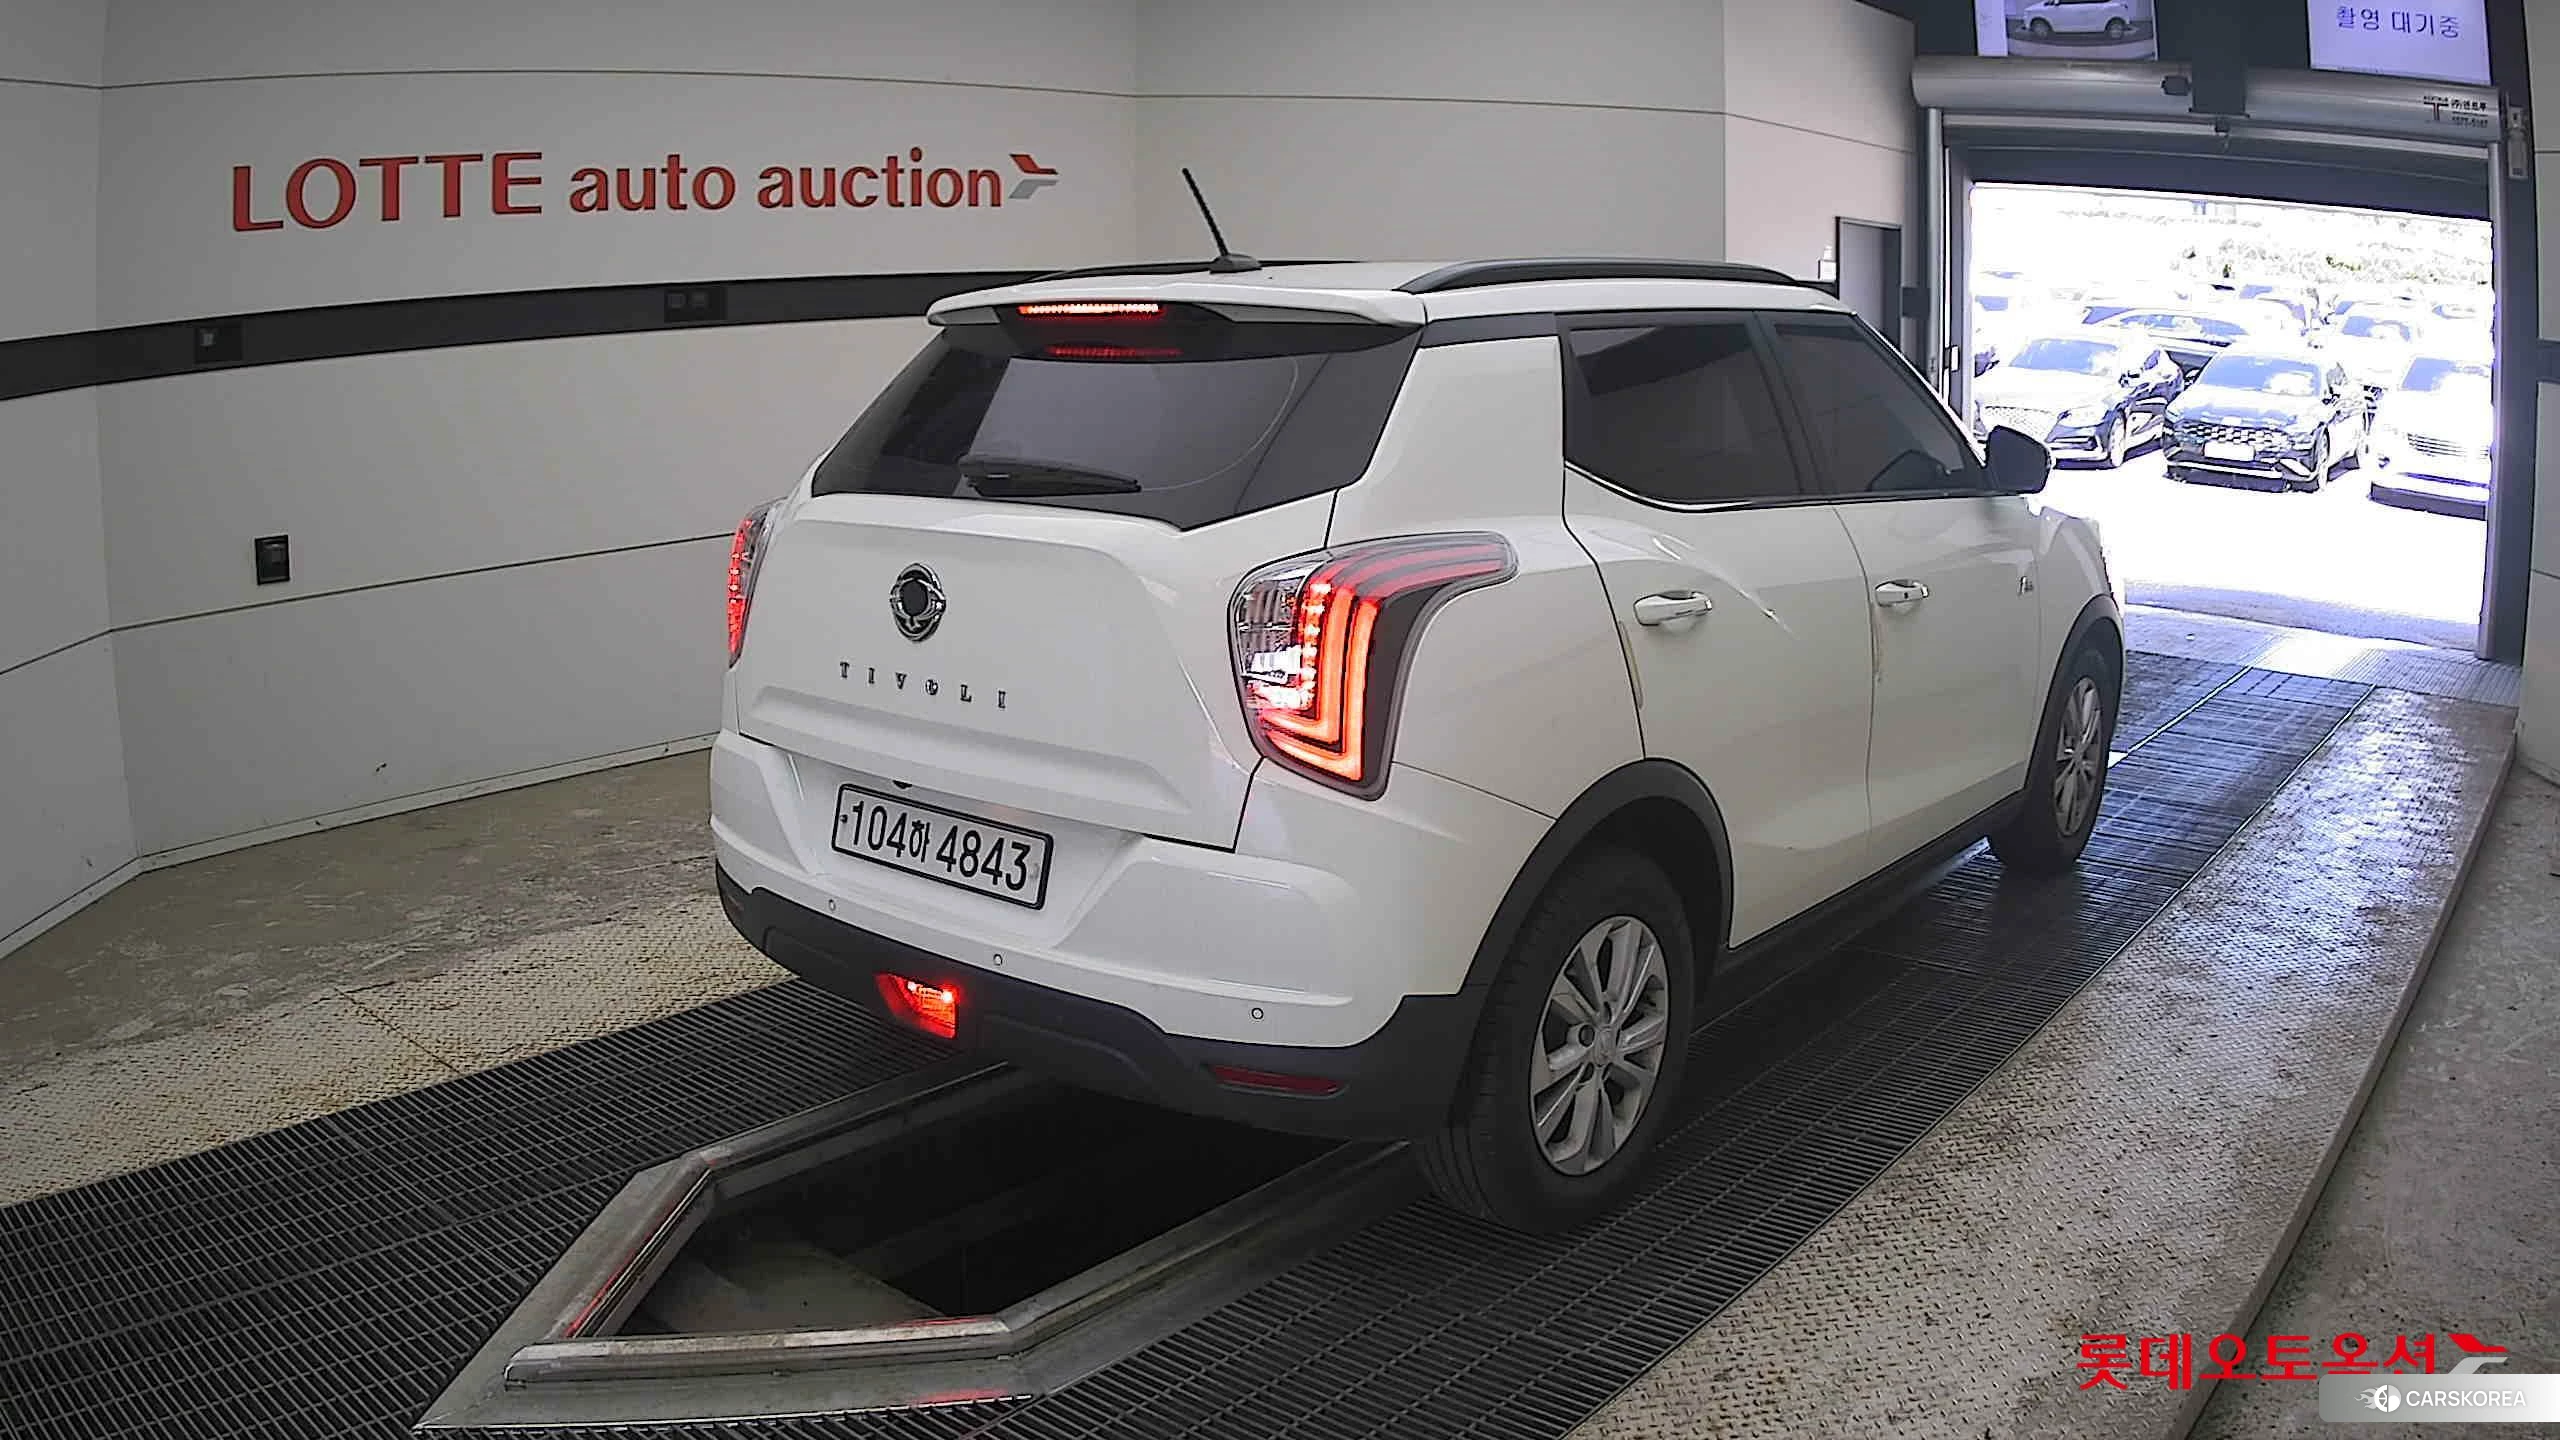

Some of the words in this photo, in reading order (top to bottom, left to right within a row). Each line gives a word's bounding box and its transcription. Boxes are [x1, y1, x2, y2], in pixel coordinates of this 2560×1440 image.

[2337, 5, 2380, 31] 촬영
[2391, 11, 2459, 39] 대기중
[232, 151, 544, 233] LOTTE
[569, 153, 737, 213] auto
[757, 147, 1004, 208] auction
[839, 660, 1007, 709] TIVOLI
[852, 800, 931, 863] 104하
[935, 824, 1032, 891] 4843
